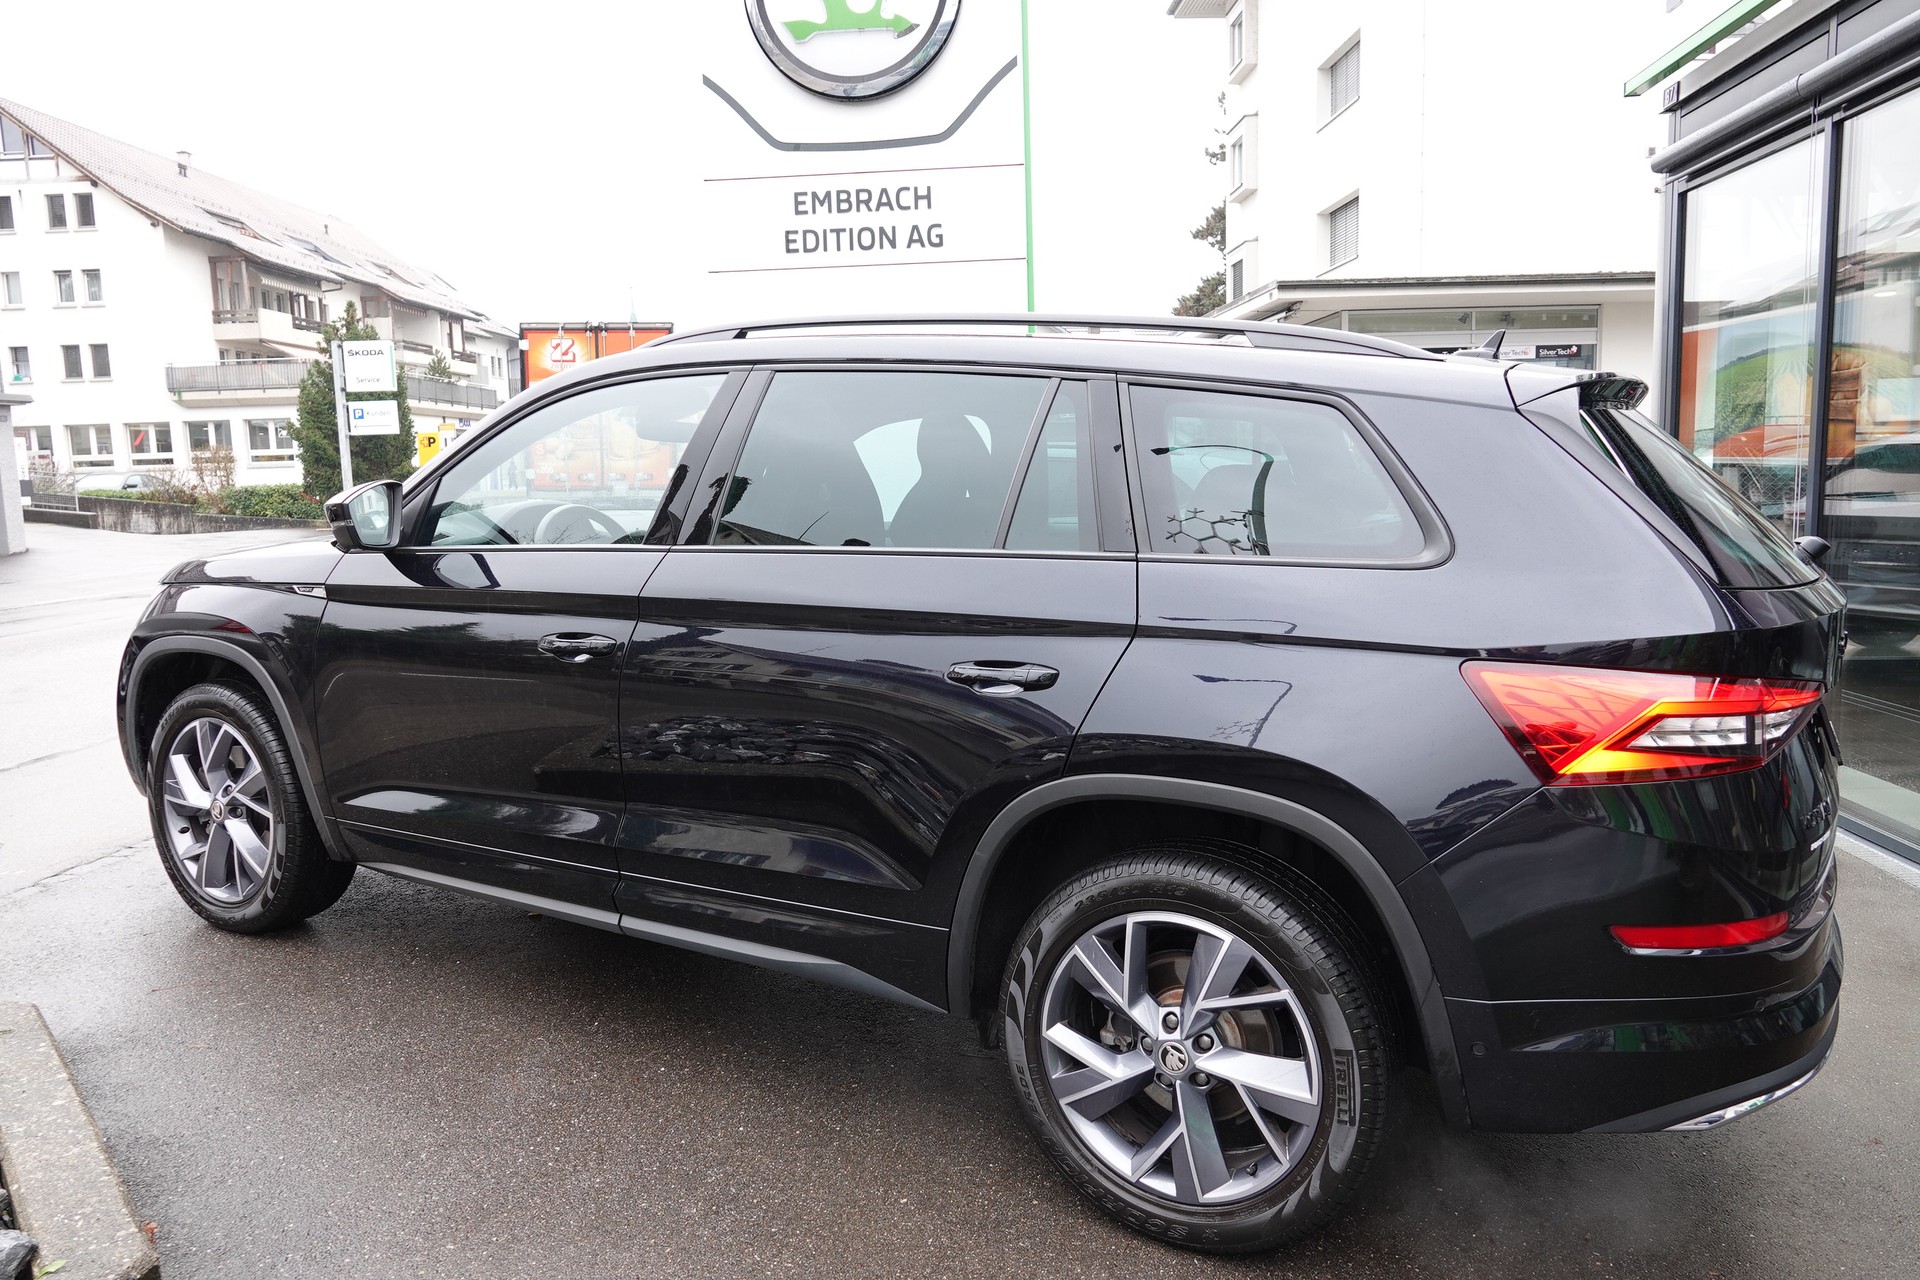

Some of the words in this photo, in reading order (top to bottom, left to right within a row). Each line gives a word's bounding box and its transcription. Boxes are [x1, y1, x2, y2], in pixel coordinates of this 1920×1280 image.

[793, 186, 932, 216] EMBRACH
[784, 225, 897, 254] EDITION
[906, 223, 944, 249] AG
[1333, 1048, 1357, 1128] PIRELLI
